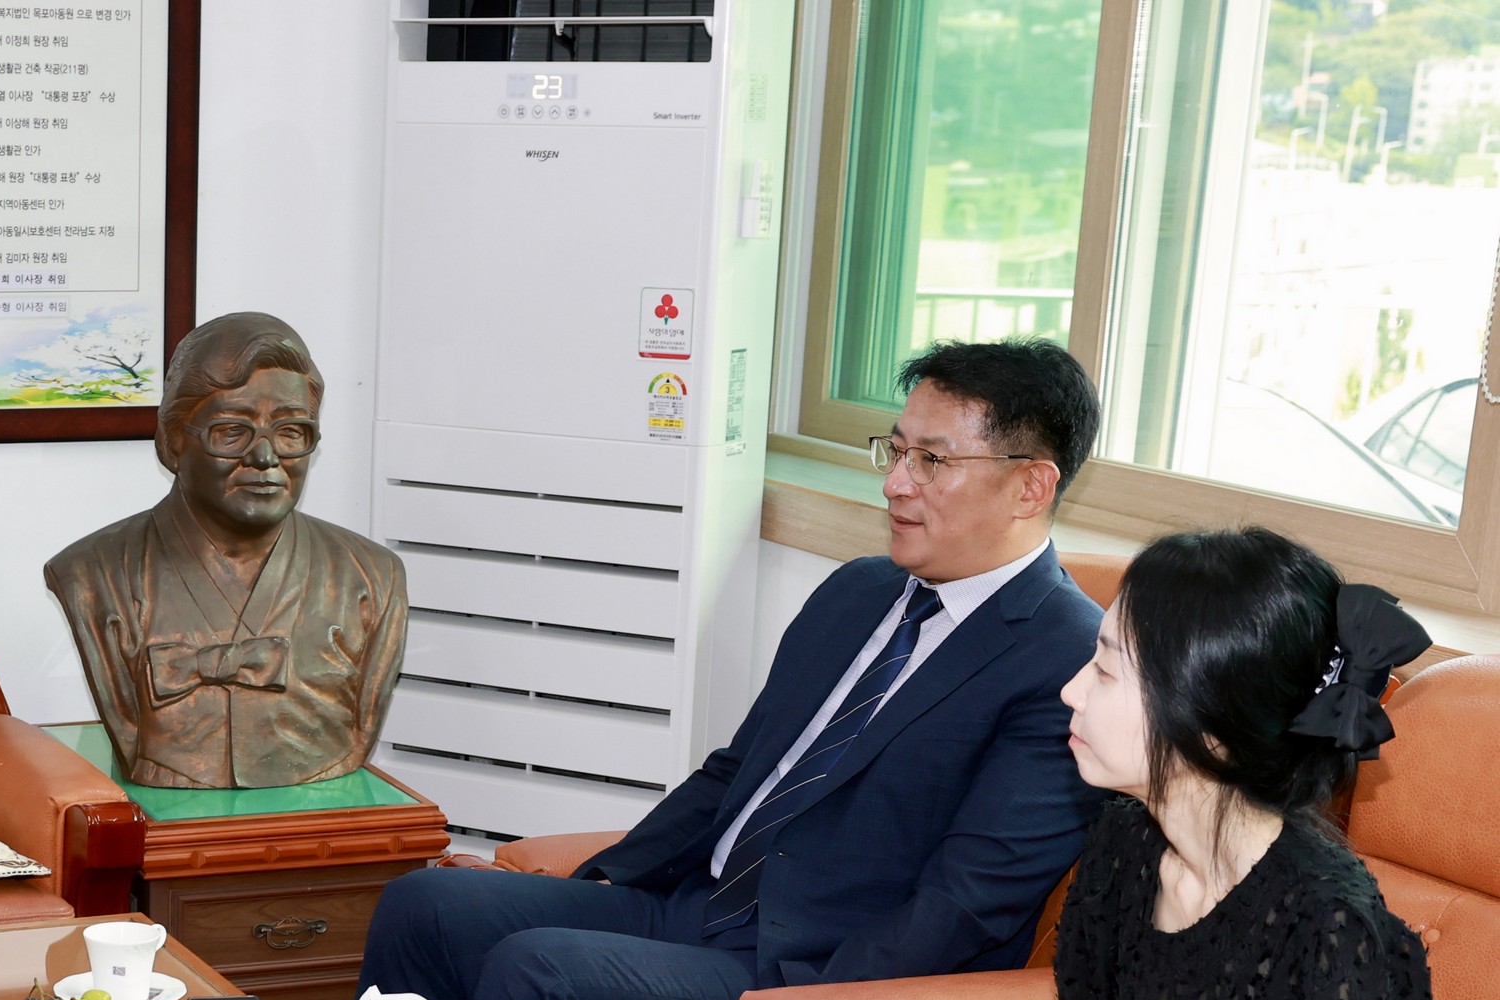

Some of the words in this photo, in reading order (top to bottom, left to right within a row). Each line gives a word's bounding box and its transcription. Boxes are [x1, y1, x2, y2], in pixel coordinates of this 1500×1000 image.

[33, 8, 73, 20] 목포아동원
[76, 9, 93, 19] 으로
[96, 10, 111, 21] 변경
[115, 10, 131, 21] 인가
[6, 35, 30, 47] 이정희
[33, 36, 49, 47] 원장
[53, 36, 68, 47] 취임
[25, 63, 41, 74] 건축
[44, 63, 88, 75] 착공(211평)
[532, 75, 562, 99] 23
[9, 91, 33, 102] 이사장
[100, 92, 115, 103] 수상
[6, 118, 29, 129] 이상해
[33, 118, 49, 129] 원장
[52, 118, 67, 129] 취임
[25, 145, 41, 156] 인가
[526, 150, 559, 162] WHISEN
[9, 172, 25, 183] 원장
[85, 173, 101, 183] 수상
[49, 199, 64, 210] 인가
[64, 226, 96, 237] 전라남도
[99, 226, 114, 237] 지정
[6, 253, 30, 263] 김미자
[32, 252, 48, 263] 원장
[52, 253, 67, 263] 취임
[15, 274, 43, 284] 이사장
[48, 275, 65, 284] 취임
[16, 302, 43, 312] 이사장
[49, 302, 66, 312] 취임
